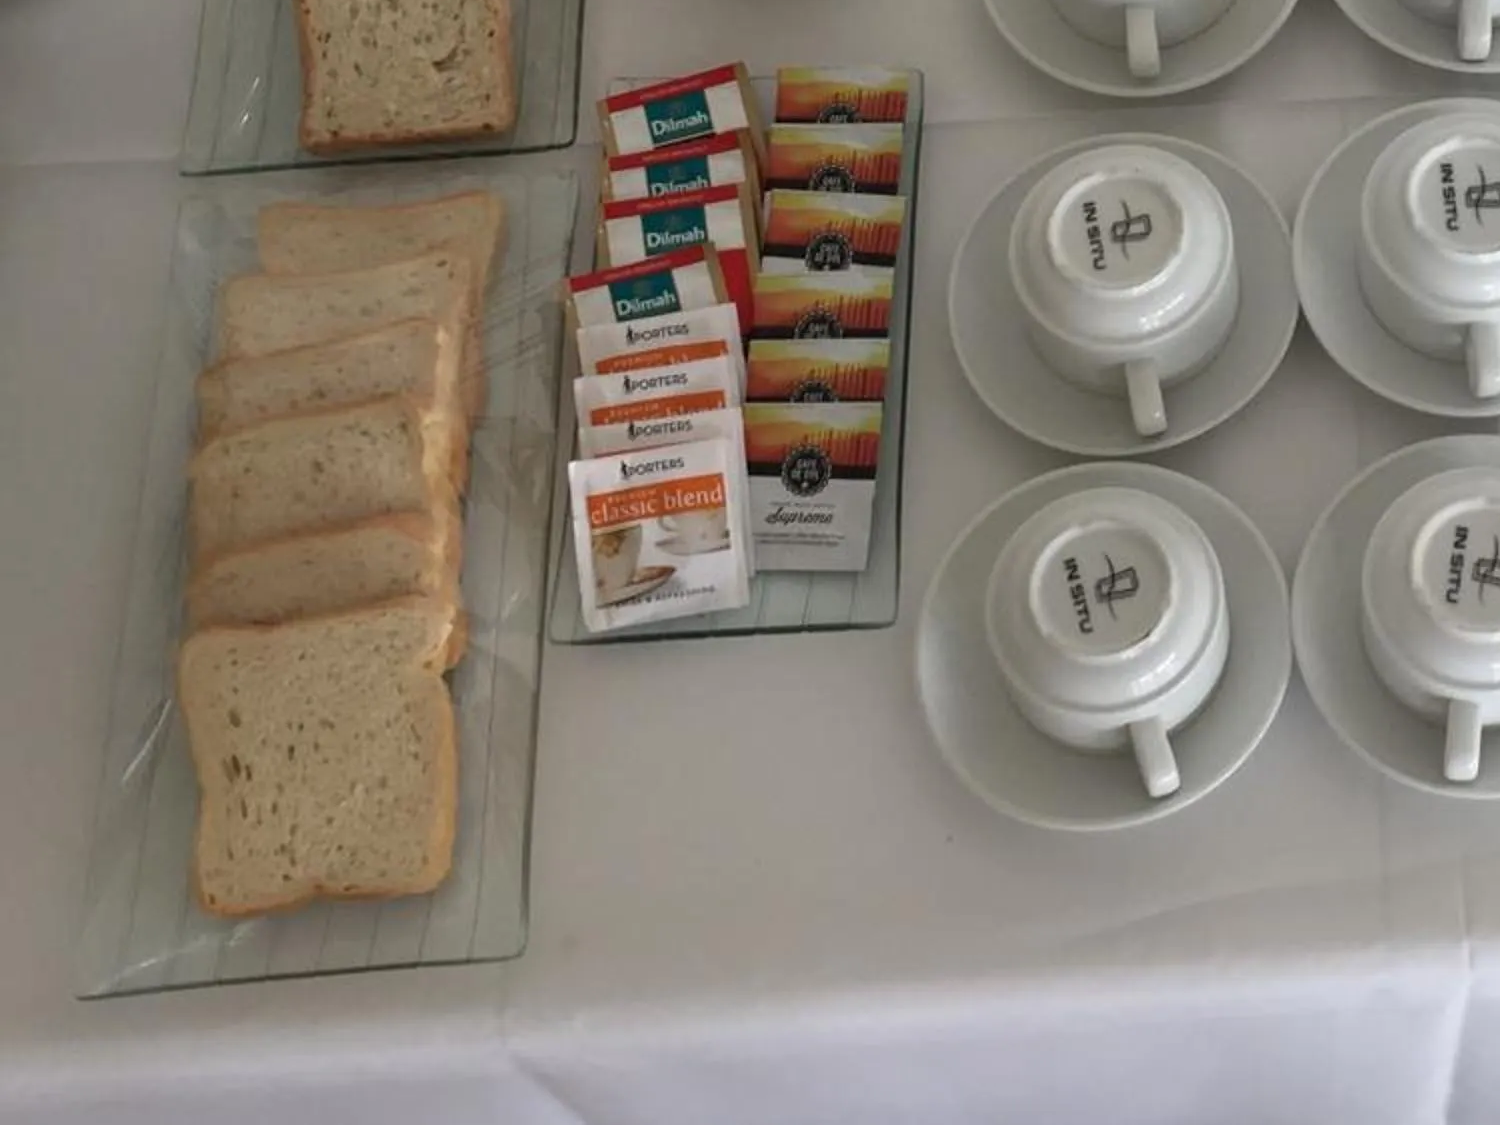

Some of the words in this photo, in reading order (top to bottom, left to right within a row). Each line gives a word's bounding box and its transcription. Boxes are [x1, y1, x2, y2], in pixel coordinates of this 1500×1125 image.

[651, 110, 709, 136] Dilmah
[1440, 162, 1454, 184] IN
[1083, 201, 1098, 223] IN
[1442, 186, 1460, 232] SITU
[646, 226, 705, 248] Dilmah
[1087, 225, 1107, 270] SITU
[616, 288, 677, 316] Dilmah
[631, 324, 689, 342] PORTERS
[630, 373, 688, 391] PORTERS
[634, 419, 693, 437] PORTERS
[626, 457, 685, 476] PORTERS
[591, 498, 658, 525] classic
[663, 482, 723, 510] blend
[1453, 526, 1469, 550] IN
[1063, 557, 1081, 582] IN
[1446, 553, 1465, 604] SITU
[1070, 583, 1093, 634] SITU
